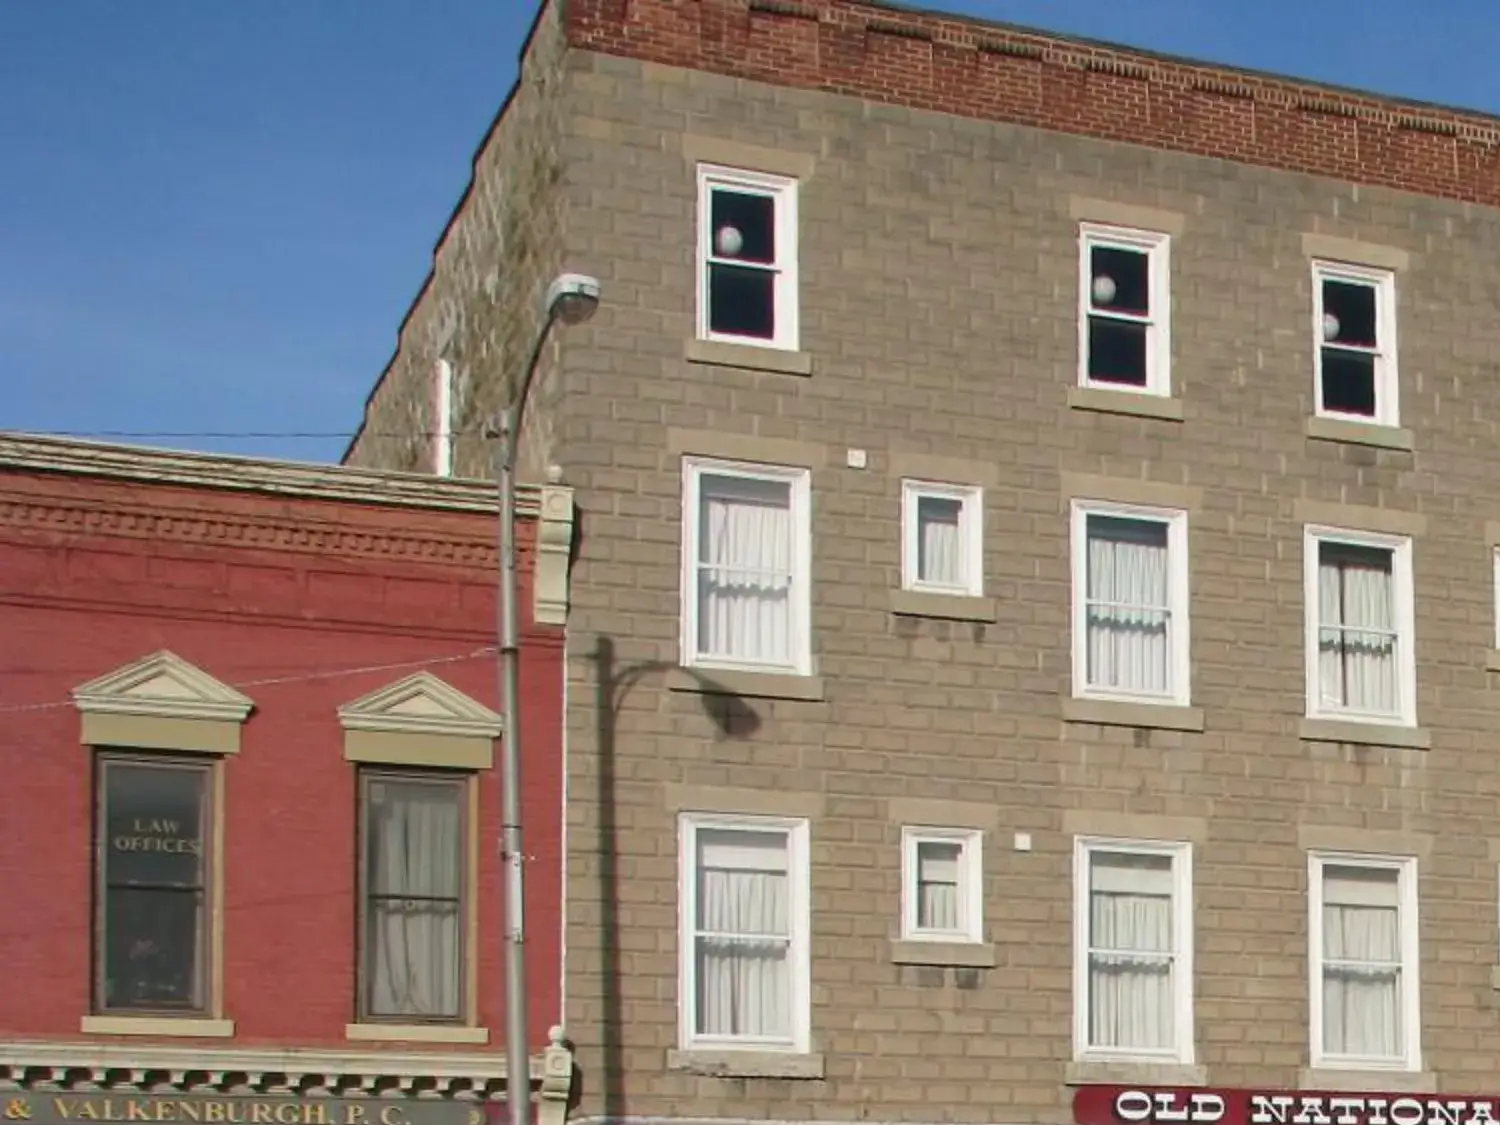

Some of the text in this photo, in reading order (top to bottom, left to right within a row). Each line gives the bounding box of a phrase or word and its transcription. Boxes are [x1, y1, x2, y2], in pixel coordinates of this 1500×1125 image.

[132, 818, 181, 834] LAW
[4, 1097, 33, 1120] &
[1116, 1090, 1225, 1122] OLD
